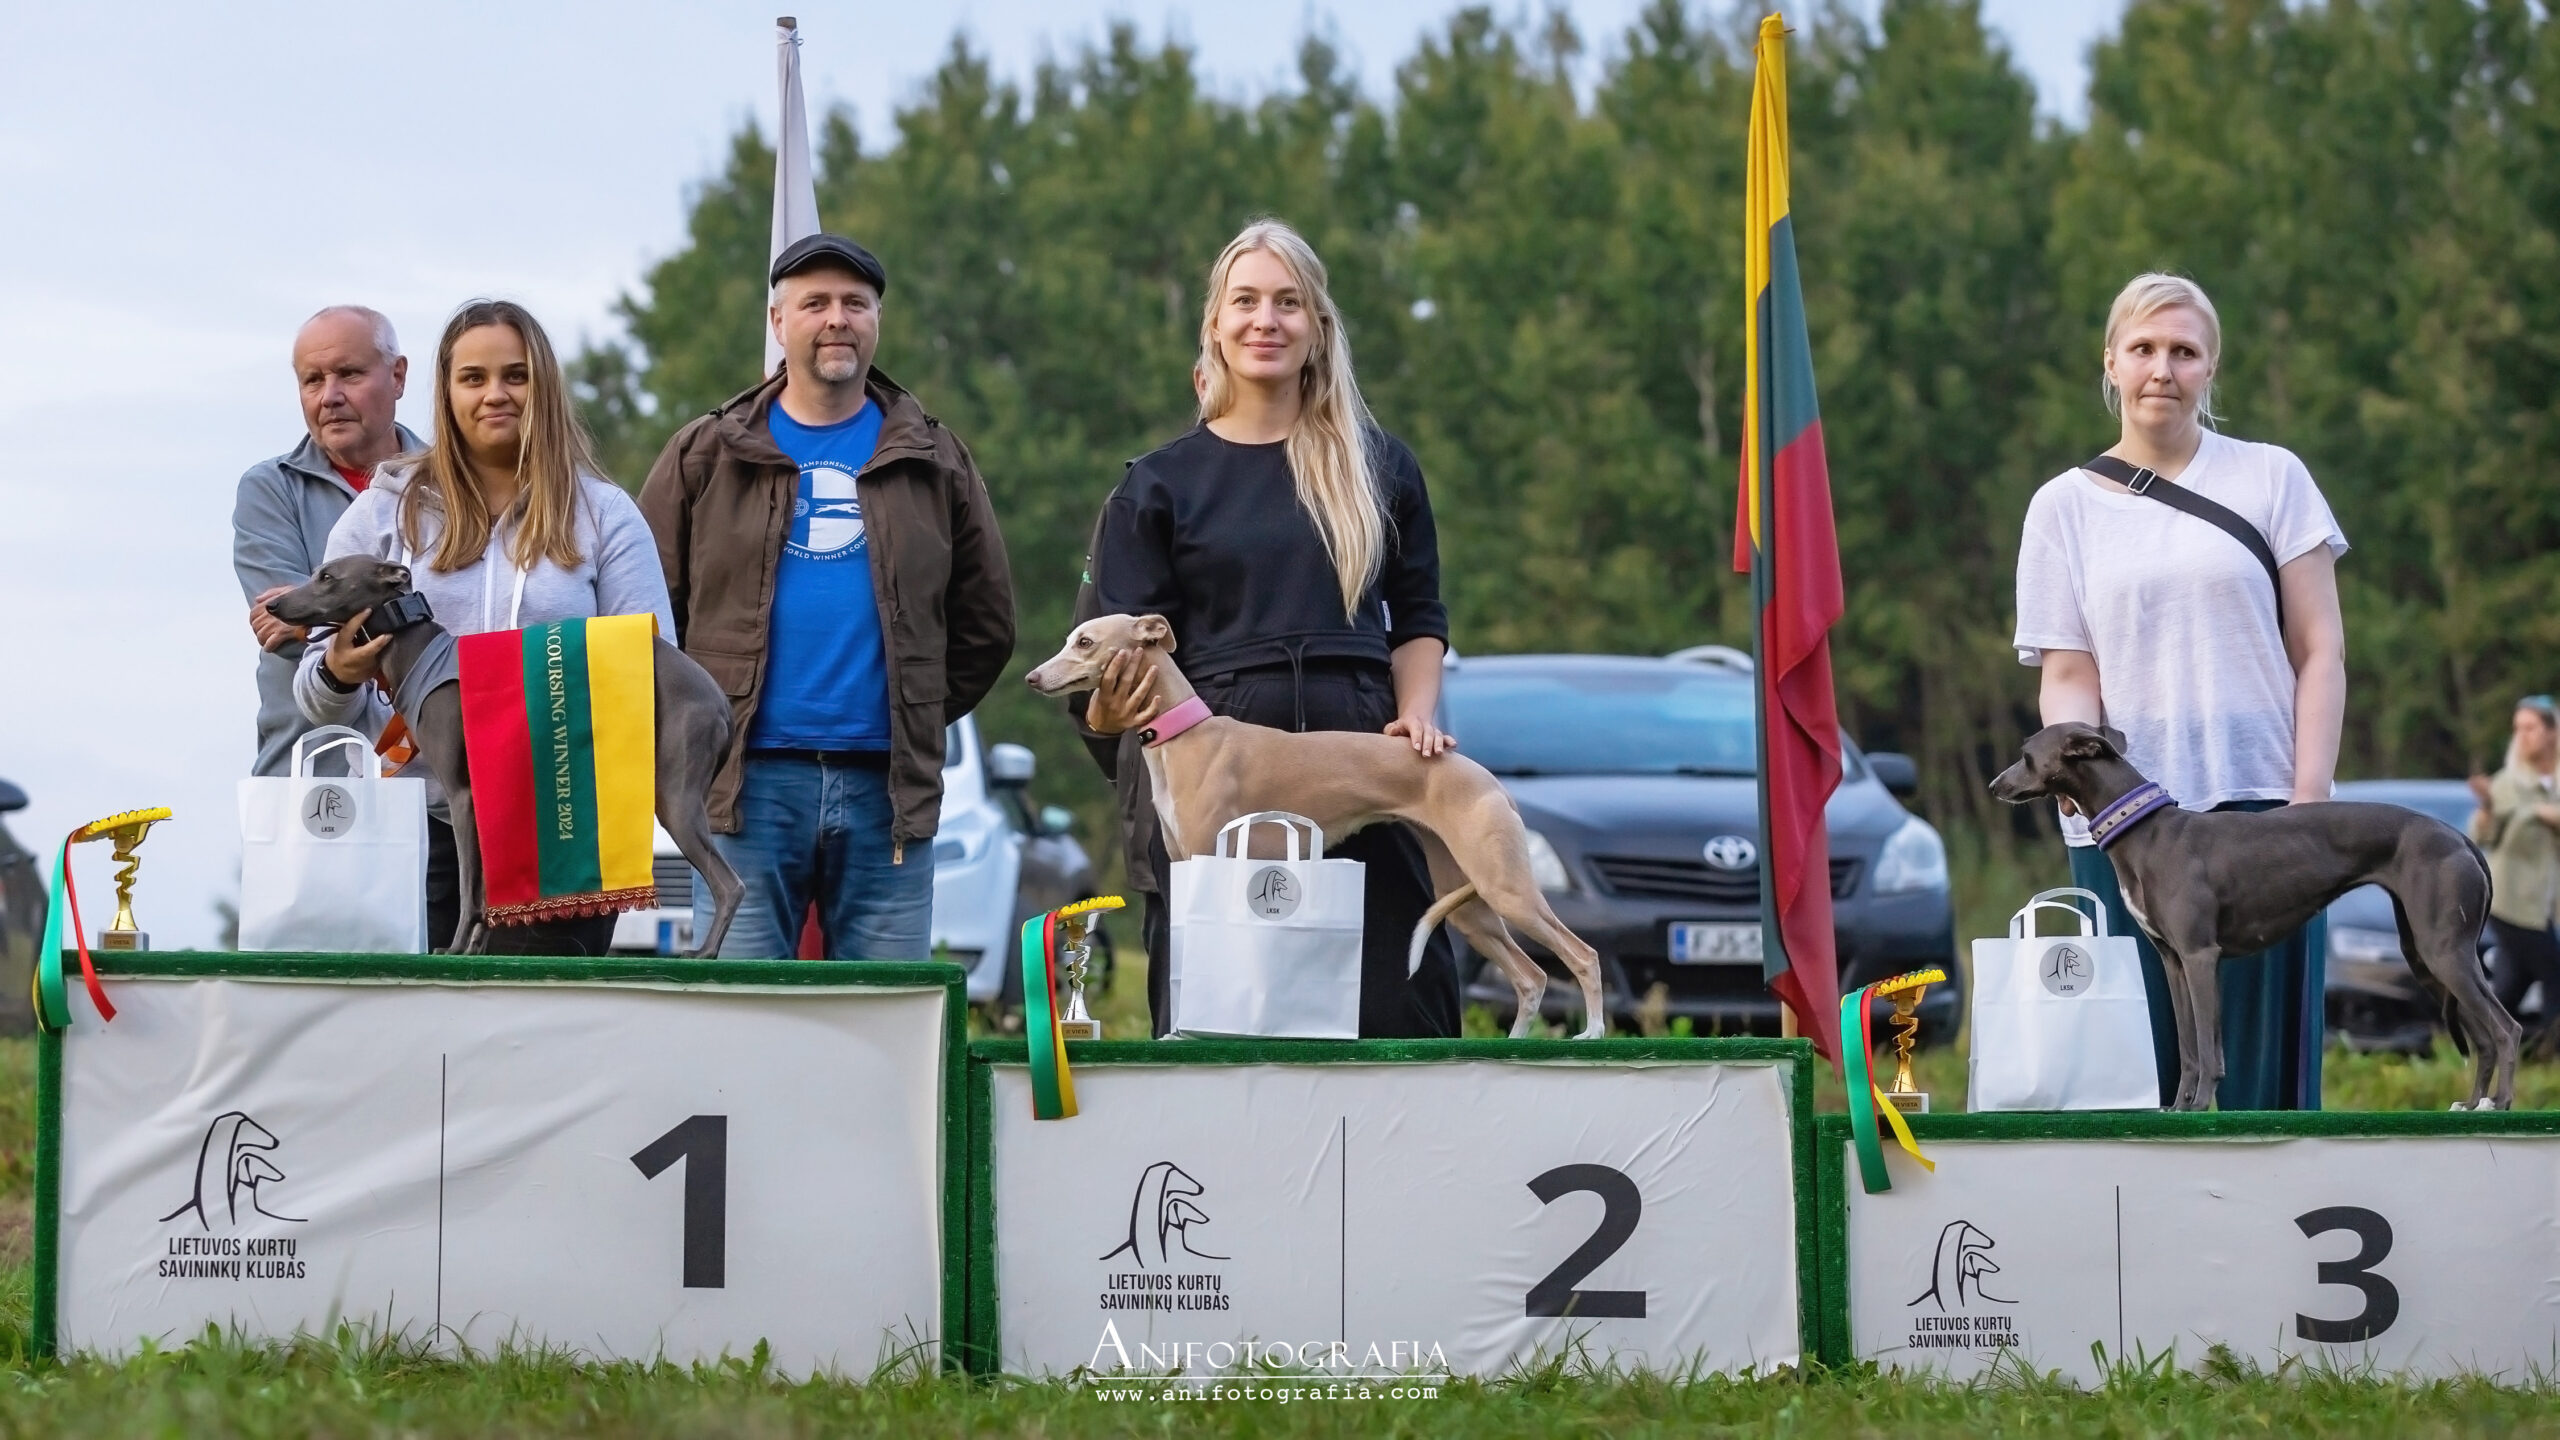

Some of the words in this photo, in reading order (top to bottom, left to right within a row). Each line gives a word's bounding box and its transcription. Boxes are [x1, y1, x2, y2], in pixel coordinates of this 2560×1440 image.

[813, 550, 847, 560] WINNER
[547, 635, 566, 721] COURSING
[553, 725, 571, 800] WINNER
[558, 803, 574, 840] 2024
[630, 1115, 728, 1289] 1
[169, 1238, 240, 1256] LIETUVOS
[246, 1239, 297, 1259] KURTŲ
[1525, 1164, 1647, 1318] 2
[158, 1260, 241, 1281] SAVININKŲ
[247, 1261, 306, 1279] KLUBAS
[2294, 1206, 2400, 1343] 3
[1108, 1274, 1173, 1291] LIETUVOS
[1177, 1274, 1221, 1293] KURTŲ
[1100, 1293, 1172, 1312] SAVININKŲ
[1177, 1294, 1230, 1311] KLUBAS
[1915, 1317, 1970, 1331] LIETUVOS
[1974, 1316, 2012, 1332] KURTŲ
[1908, 1334, 1970, 1350] SAVININKŲ
[1974, 1333, 2019, 1348] KLUBAS
